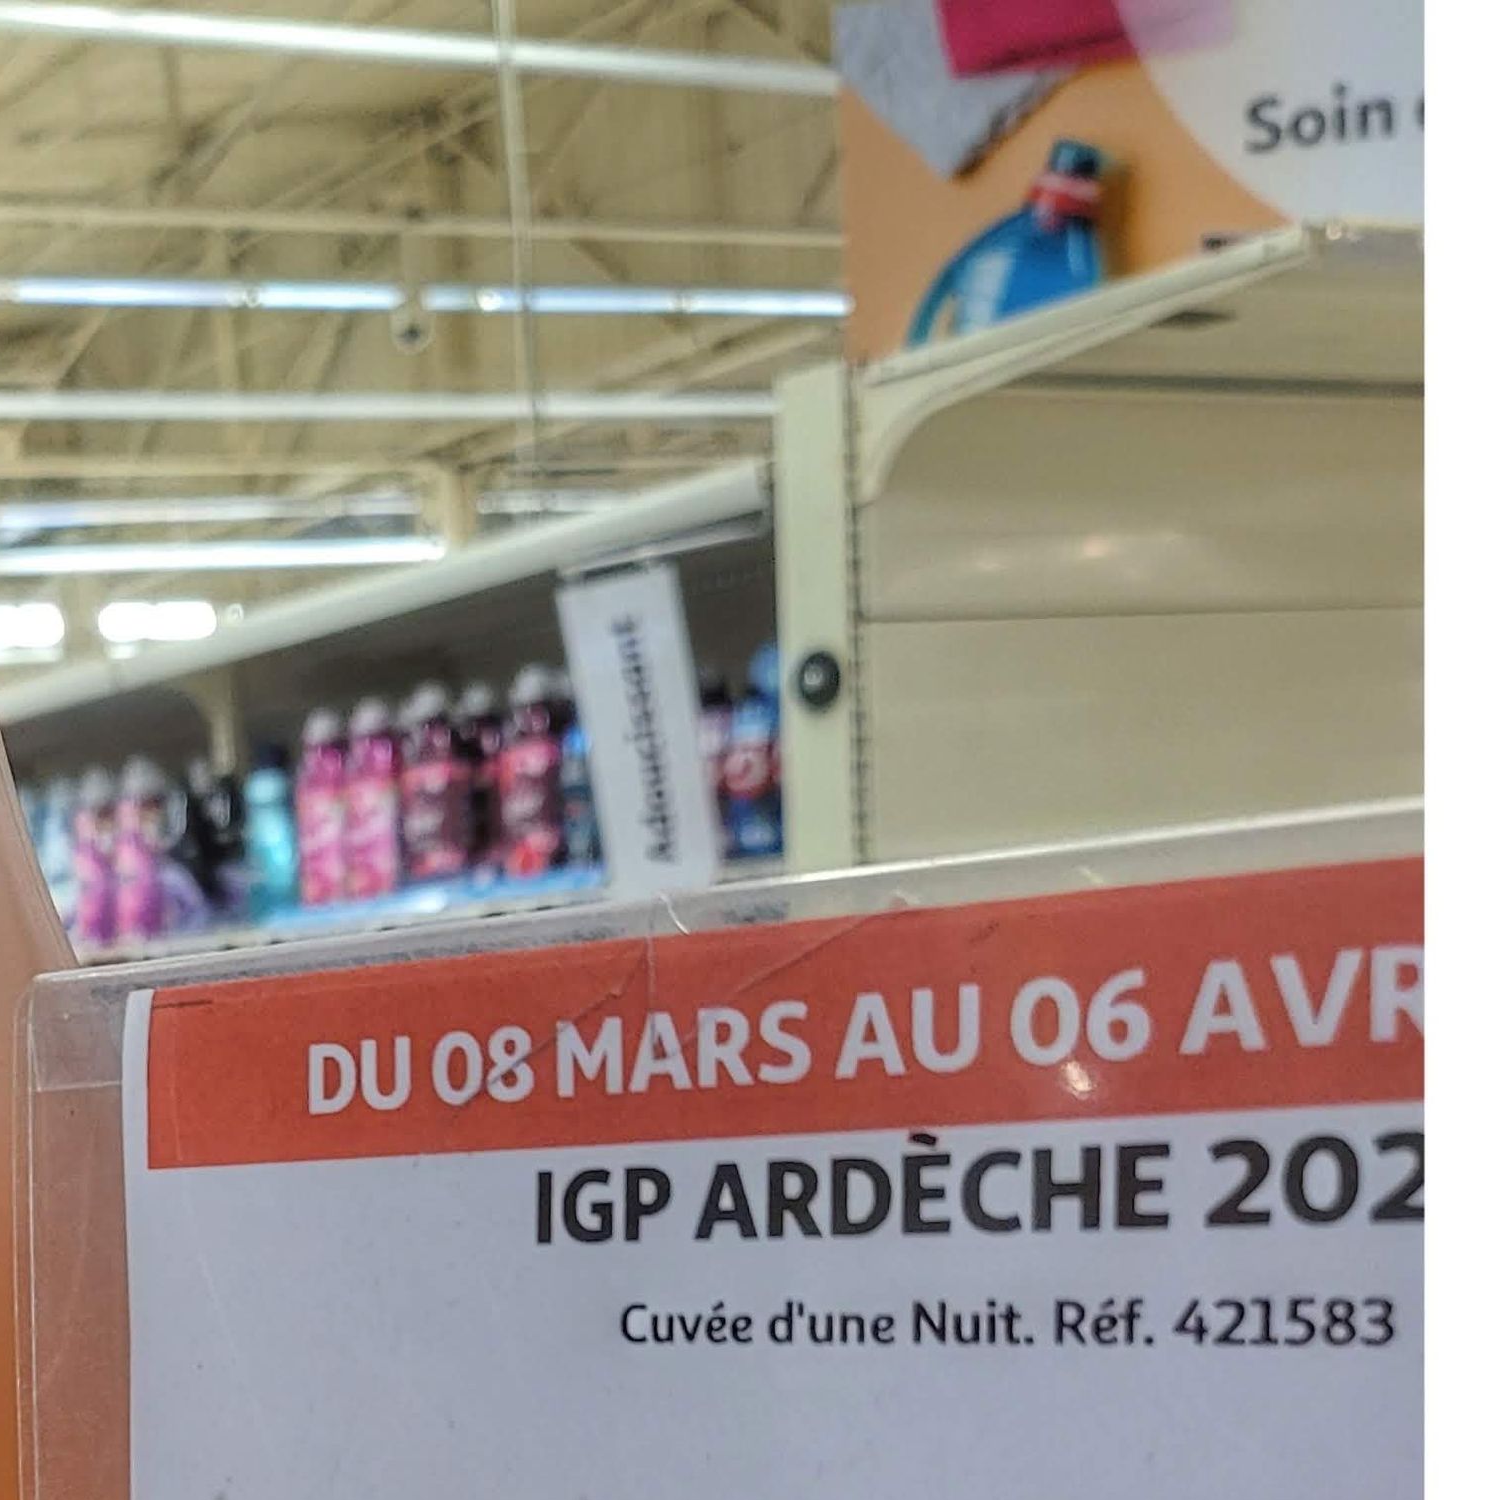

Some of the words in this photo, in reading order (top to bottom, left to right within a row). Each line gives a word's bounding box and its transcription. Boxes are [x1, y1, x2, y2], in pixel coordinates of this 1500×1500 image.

[1244, 83, 1394, 155] Soin
[309, 1034, 411, 1115] DU
[432, 1026, 534, 1106] 08
[556, 1000, 812, 1098] MARS
[835, 983, 980, 1080] AU
[1010, 967, 1151, 1066] 06
[536, 1168, 672, 1244] IGP
[694, 1131, 1170, 1240] ARDÈCHE
[621, 1301, 753, 1344] Cuvée
[768, 1300, 895, 1344] d'une
[912, 1300, 1033, 1346] Nuit.
[1054, 1300, 1154, 1347] Réf.
[1174, 1300, 1395, 1347] 421583
